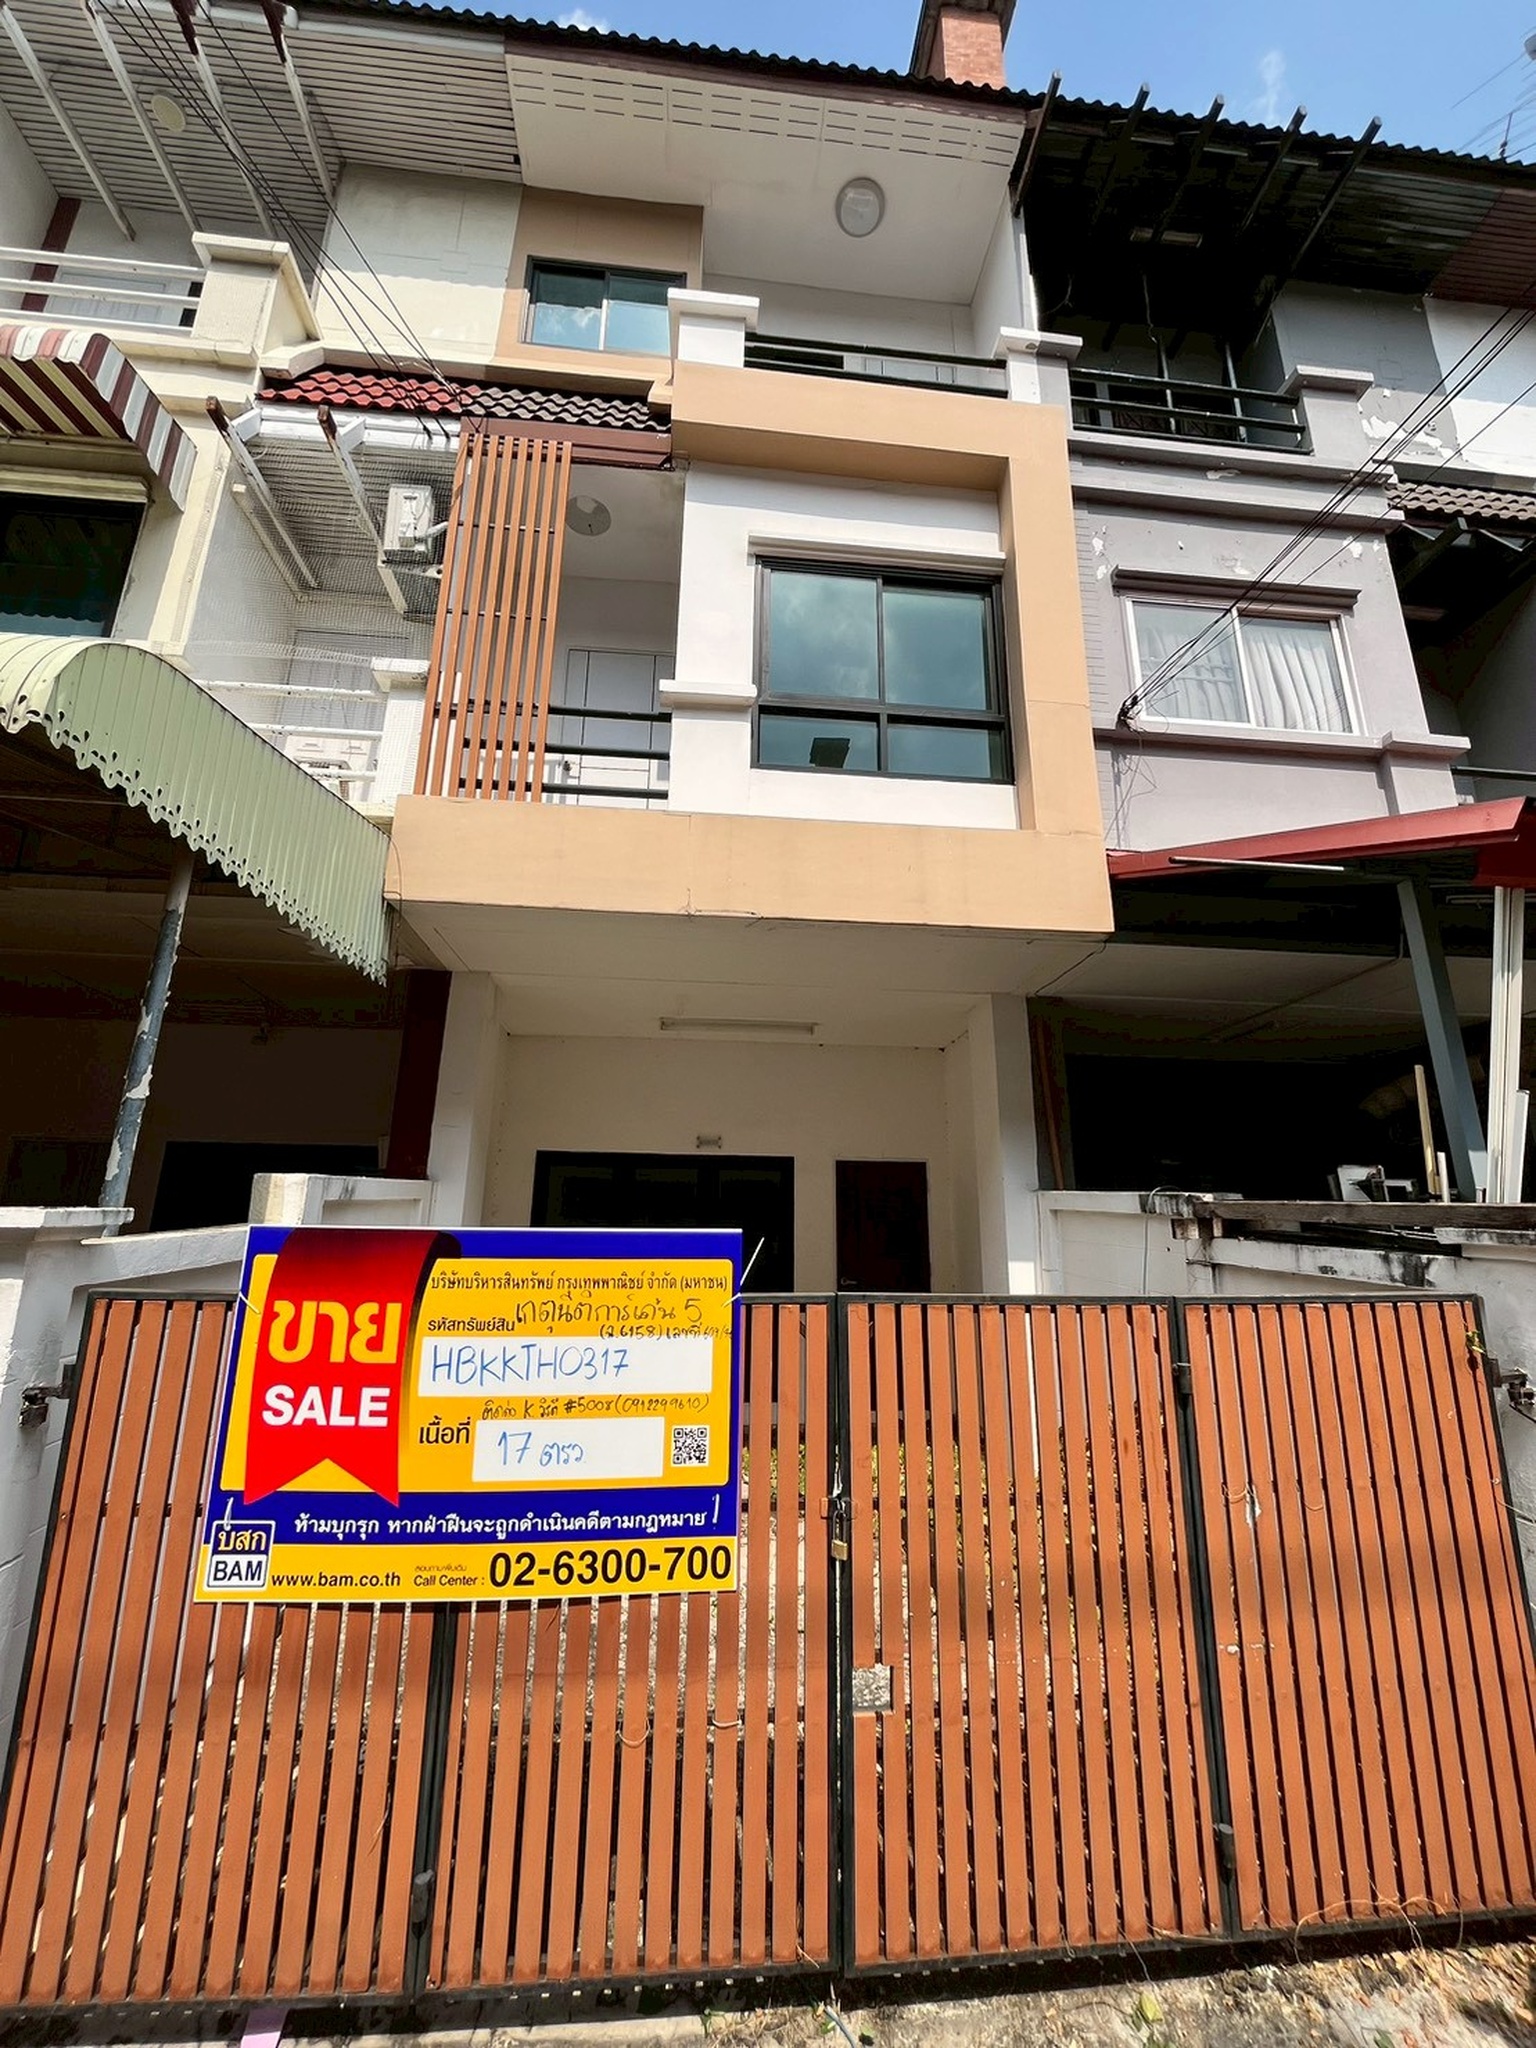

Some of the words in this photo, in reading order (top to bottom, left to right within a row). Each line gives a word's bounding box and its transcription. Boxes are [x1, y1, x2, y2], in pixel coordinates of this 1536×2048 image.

[431, 1270, 556, 1290] บริษัทบริหารสินทรัพย์
[557, 1270, 645, 1295] กรุงเทพพาณิชย์
[647, 1271, 677, 1289] จำกัด
[680, 1275, 727, 1291] (มหาชน)
[684, 1298, 702, 1322] 5
[268, 1300, 402, 1364] ขาย
[427, 1317, 516, 1332] รหัสทรัพย์สิน
[262, 1384, 391, 1427] SALE
[419, 1415, 472, 1444] เนื้อที่
[497, 1431, 532, 1465] 17
[294, 1513, 380, 1540] ห้ามบุกรุก
[387, 1510, 706, 1540] หากฝ่าฝืนจะถูกดำเนินคดีตามกฎหมาย
[218, 1530, 267, 1551] บสก
[213, 1560, 263, 1581] BAM
[271, 1572, 401, 1587] www.bam.co.th
[413, 1574, 436, 1587] Call
[438, 1574, 478, 1587] Center
[489, 1545, 732, 1588] 02-6300-700
